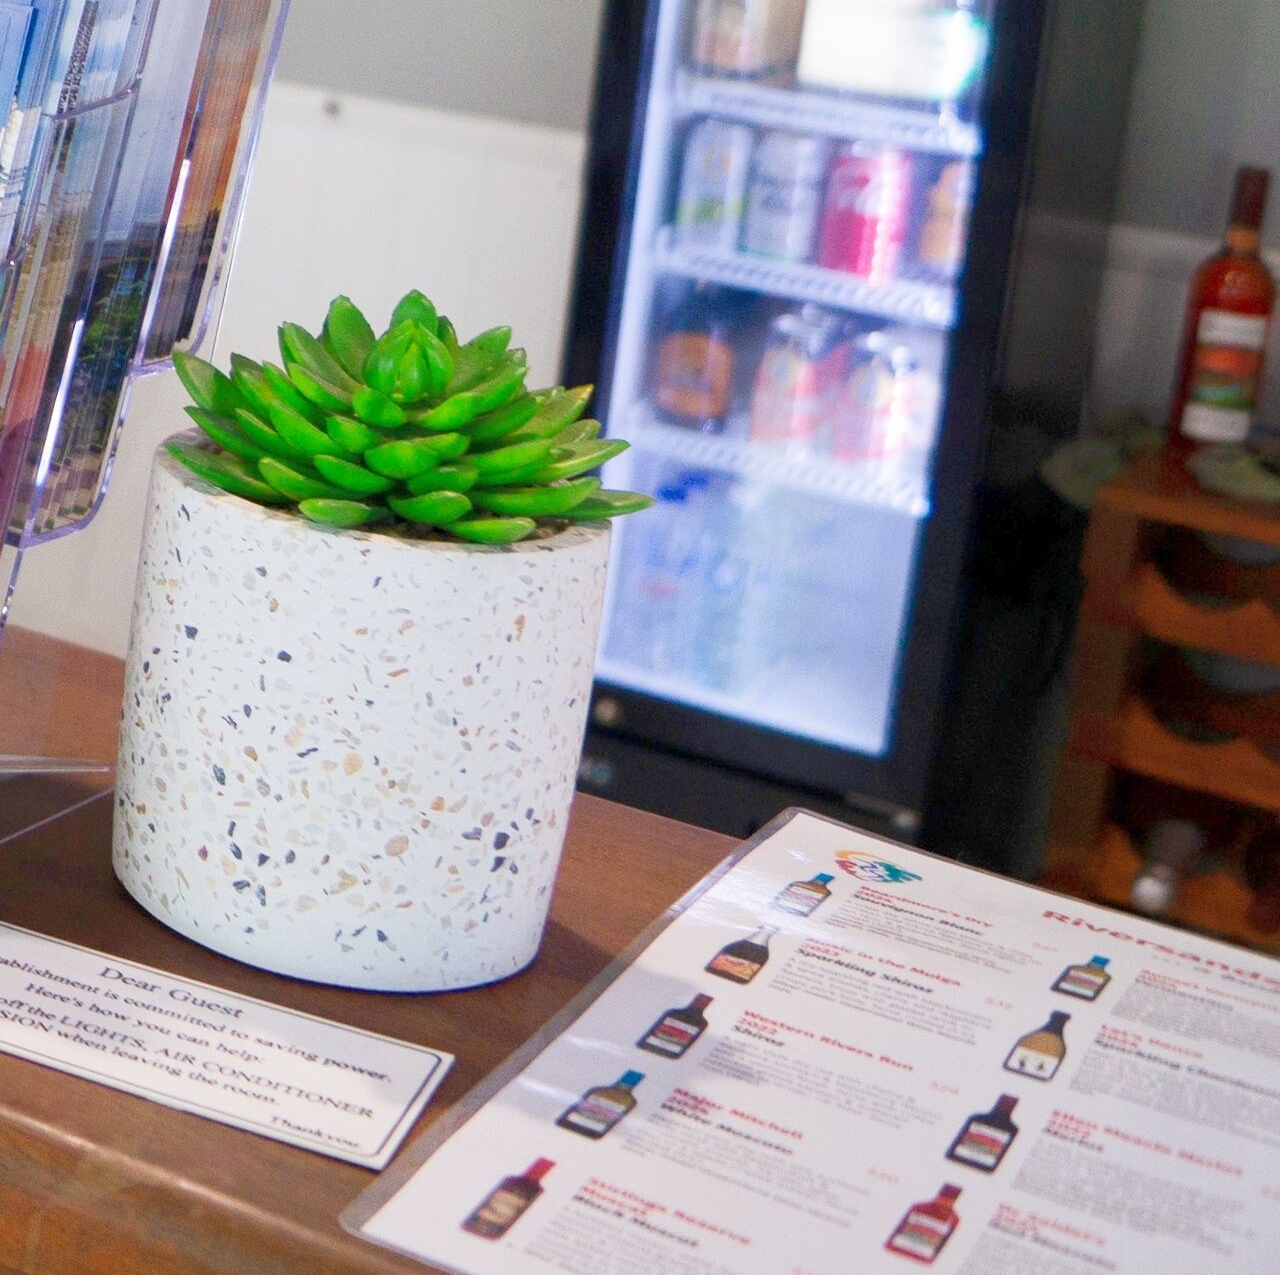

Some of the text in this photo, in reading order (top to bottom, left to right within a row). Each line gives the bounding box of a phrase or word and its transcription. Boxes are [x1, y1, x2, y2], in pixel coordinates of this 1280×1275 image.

[99, 965, 244, 1019] Dear Guest
[796, 947, 935, 994] Sparkling Shiraz
[24, 982, 265, 1065] Here's how you can help:
[103, 988, 120, 1000] is
[122, 996, 227, 1033] committed
[230, 1028, 249, 1040] to
[254, 1037, 320, 1063] saving
[322, 1057, 392, 1084] power.
[733, 1024, 785, 1048] Shiraz
[744, 1009, 815, 1039] Western
[820, 1035, 874, 1059] Rivers
[27, 1006, 57, 1021] the
[59, 1015, 148, 1052] LIGHTS,
[154, 1046, 197, 1066] AIR
[201, 1060, 375, 1120] CONDITIONER
[56, 1029, 108, 1052] when
[111, 1045, 182, 1078] leaving
[188, 1071, 219, 1086] the
[222, 1083, 280, 1106] room.
[270, 1115, 323, 1138] Thank
